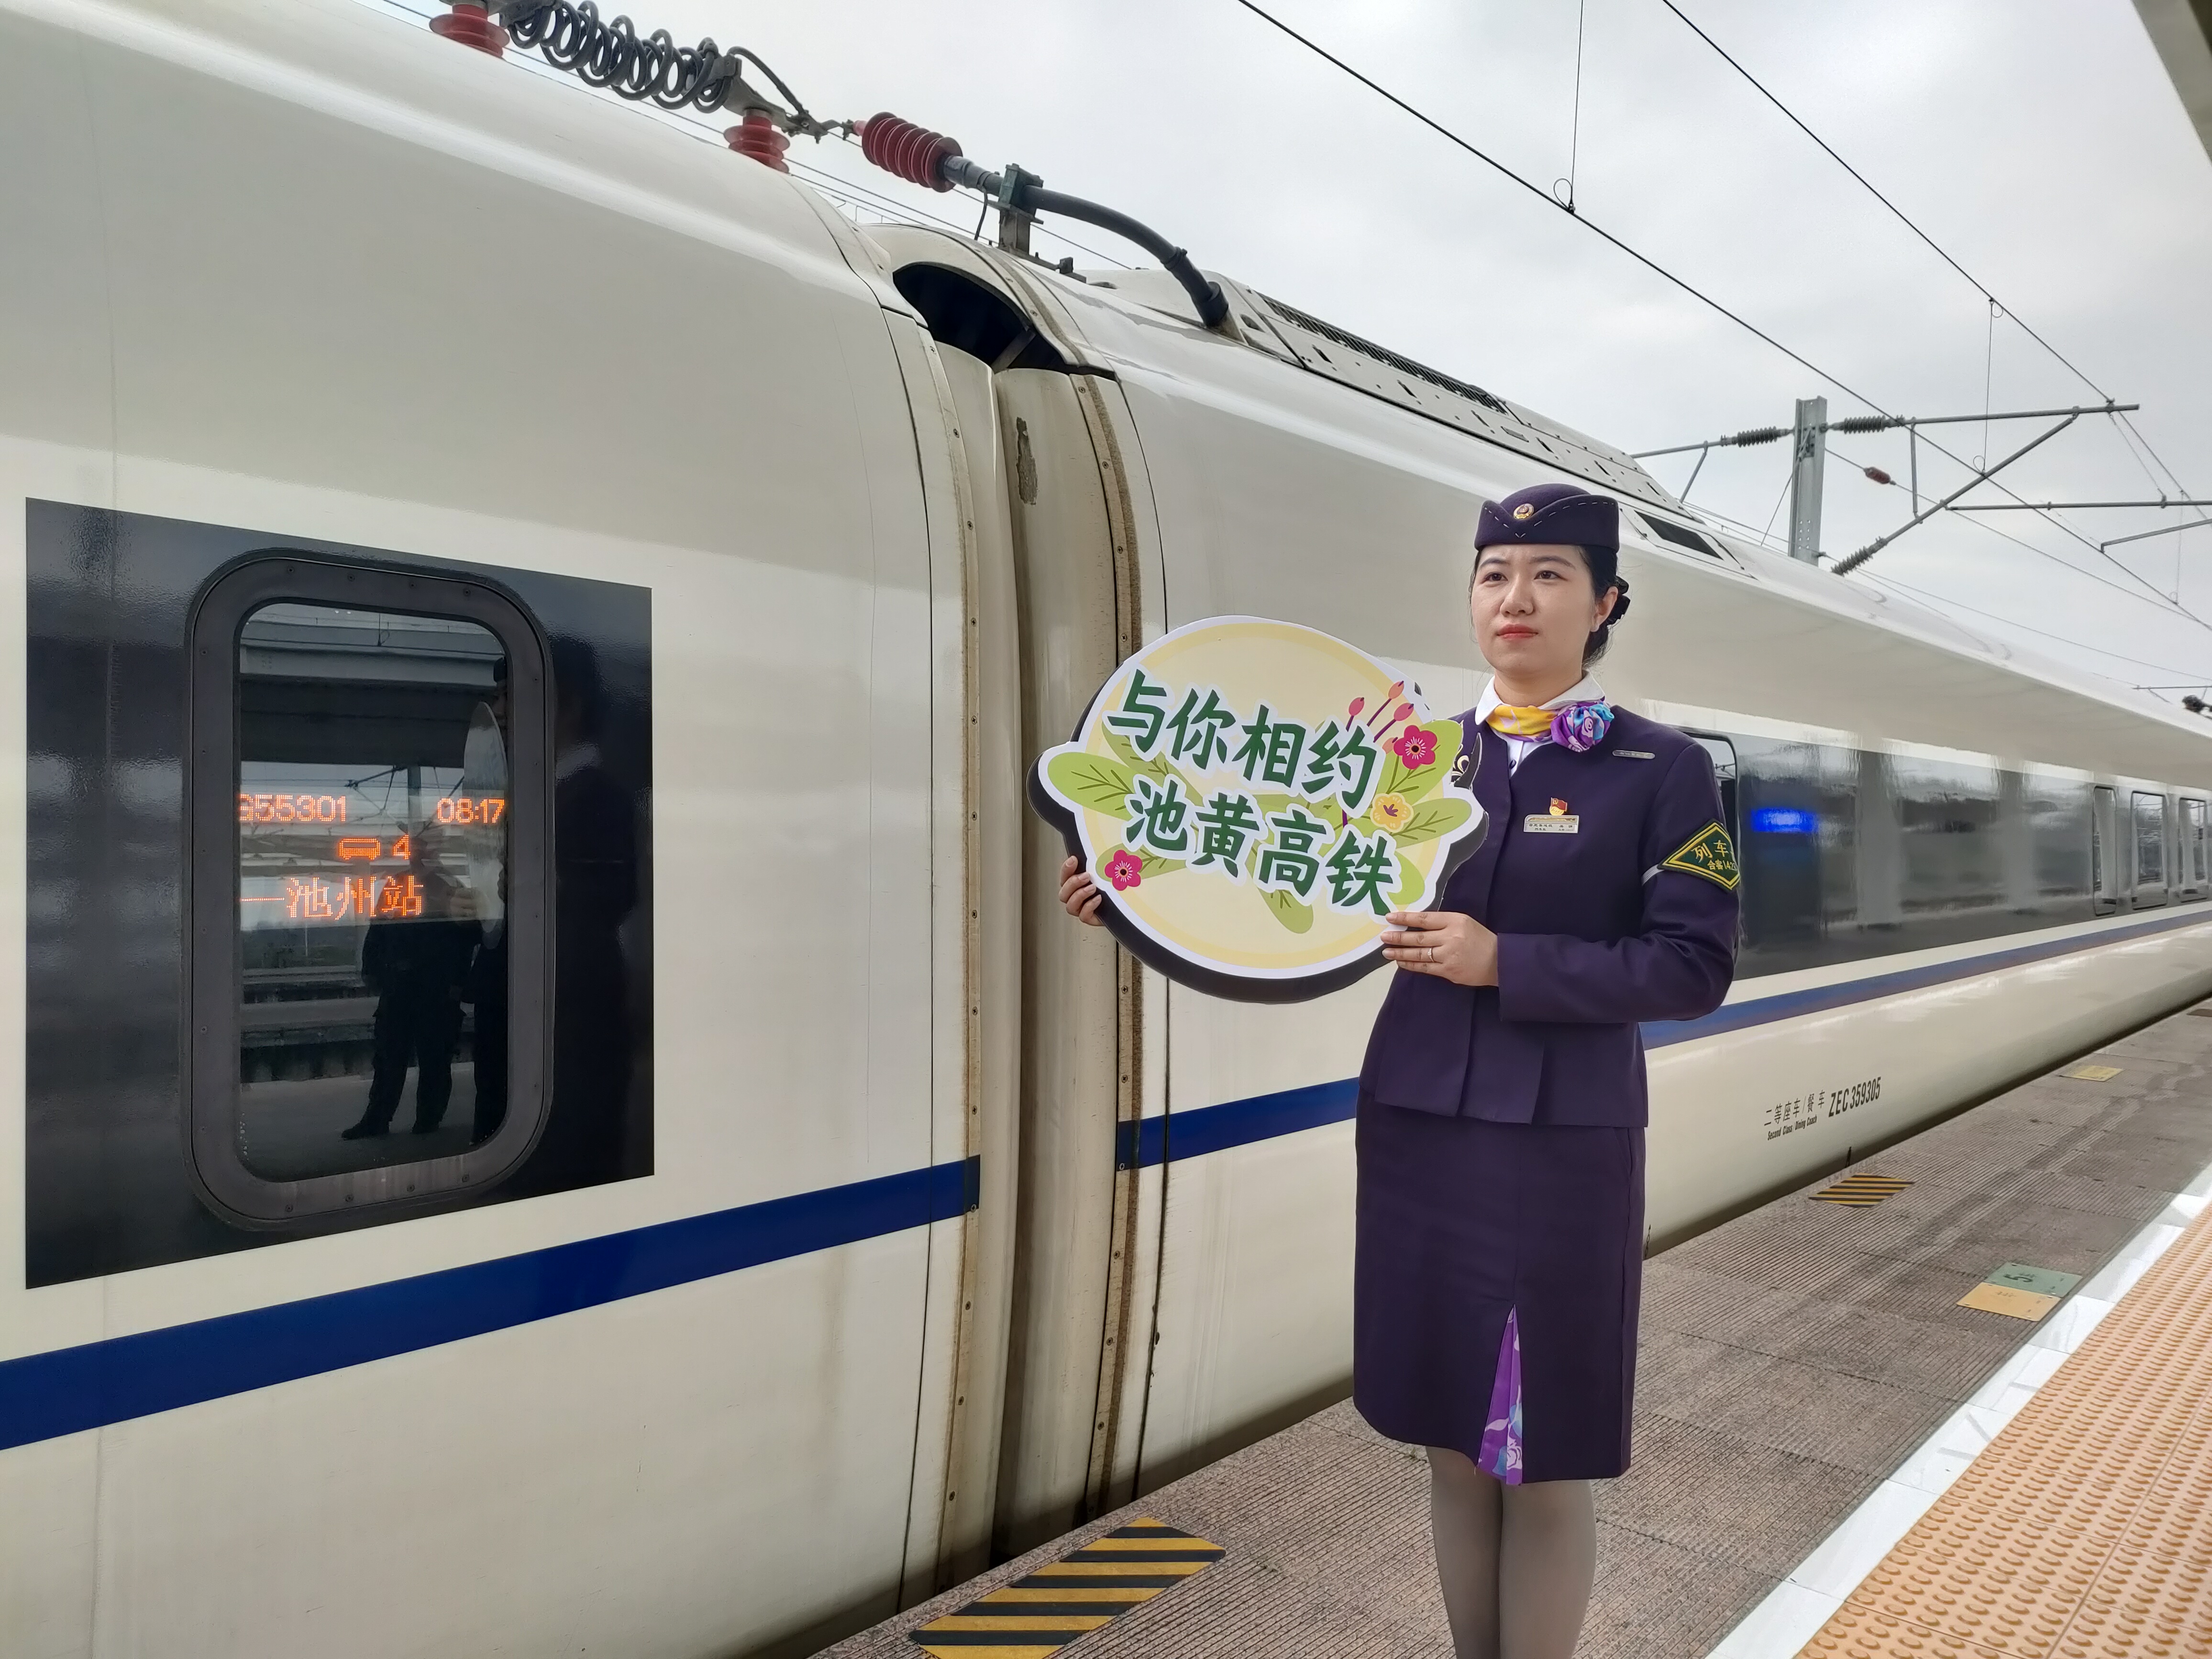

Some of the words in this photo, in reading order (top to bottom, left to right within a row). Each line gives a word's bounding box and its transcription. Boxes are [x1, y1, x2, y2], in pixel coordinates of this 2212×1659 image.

[1107, 669, 1377, 810] 与你相约
[437, 798, 505, 823] 08:17
[393, 834, 411, 859] 4
[1126, 780, 1395, 916] 池黄高铁
[1829, 1089, 1849, 1117] ZEC
[1850, 1077, 1881, 1109] 359305
[1768, 1127, 1782, 1141] Second
